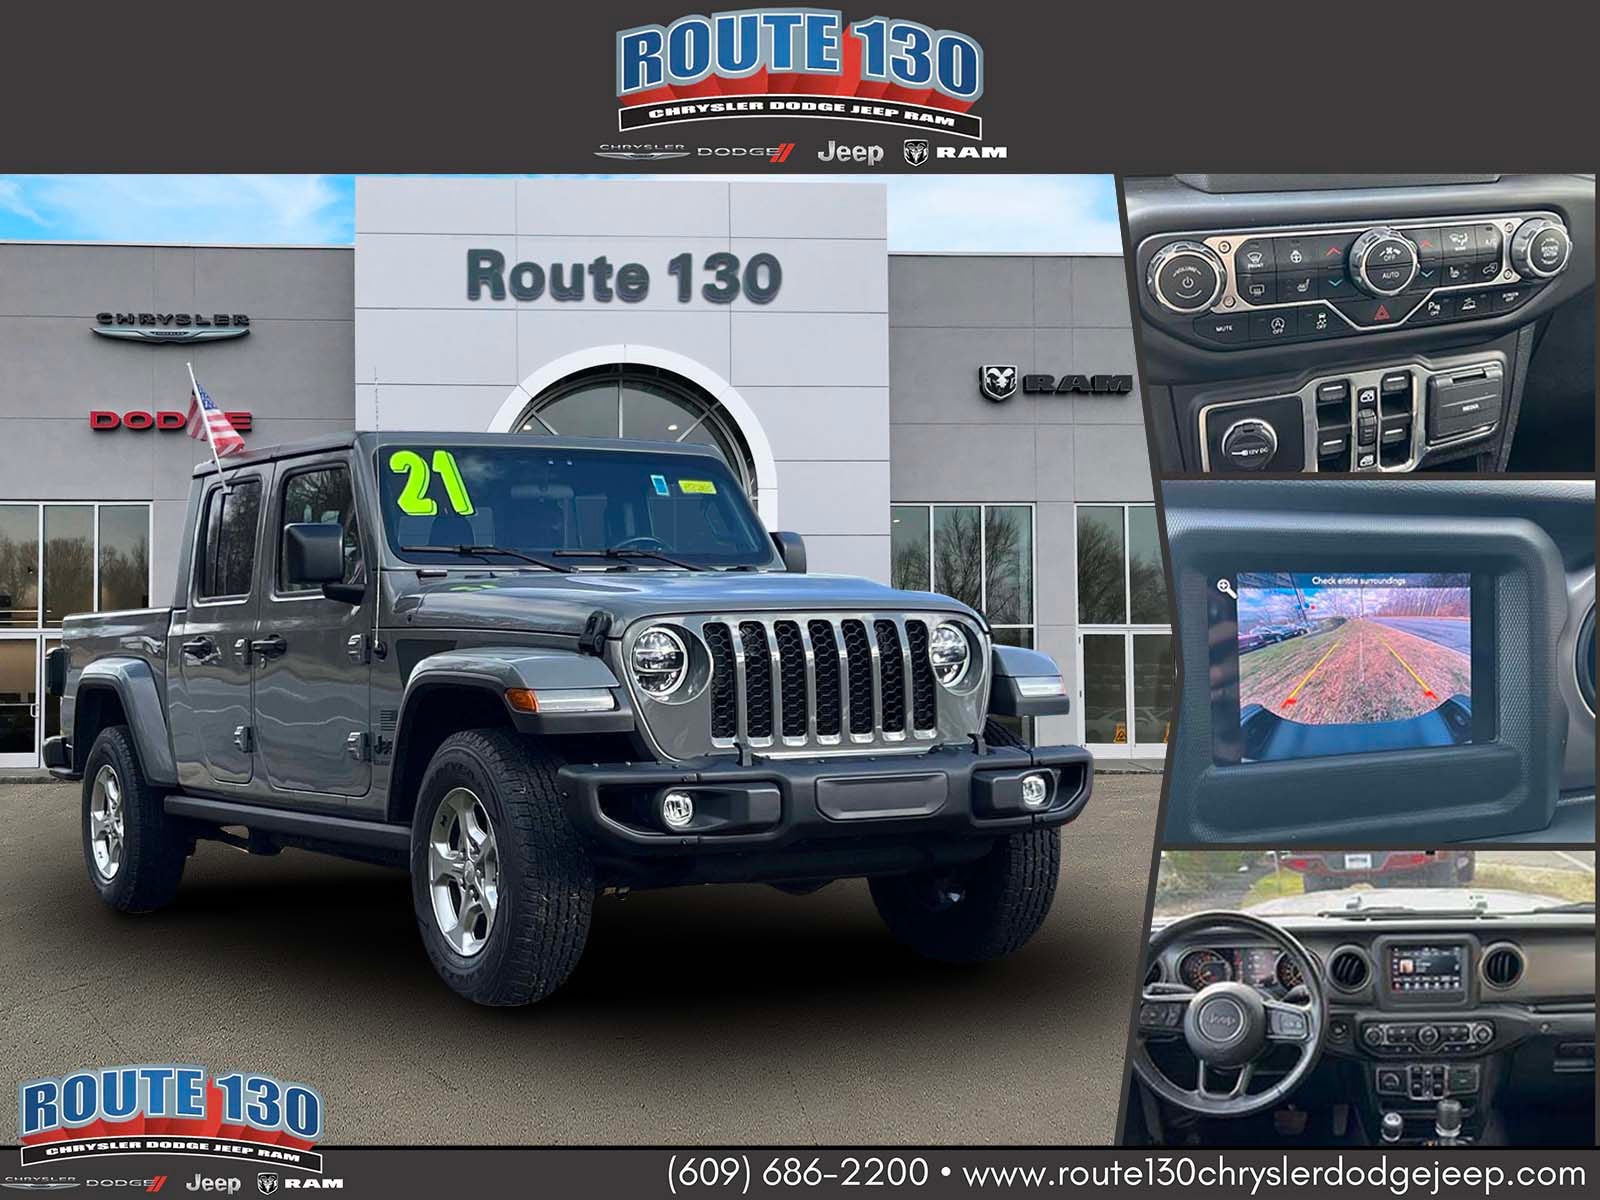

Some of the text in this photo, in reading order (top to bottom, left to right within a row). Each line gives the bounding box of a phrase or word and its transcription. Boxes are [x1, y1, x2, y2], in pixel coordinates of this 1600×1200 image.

[466, 248, 783, 305] Route 130
[1382, 271, 1400, 279] AUTO
[96, 312, 250, 326] CHRYSLER
[1215, 324, 1233, 332] MUTE
[1022, 374, 1133, 394] RAM
[89, 411, 252, 431] DODE
[389, 449, 475, 516] 21
[1311, 575, 1407, 587] Check entire surroundings
